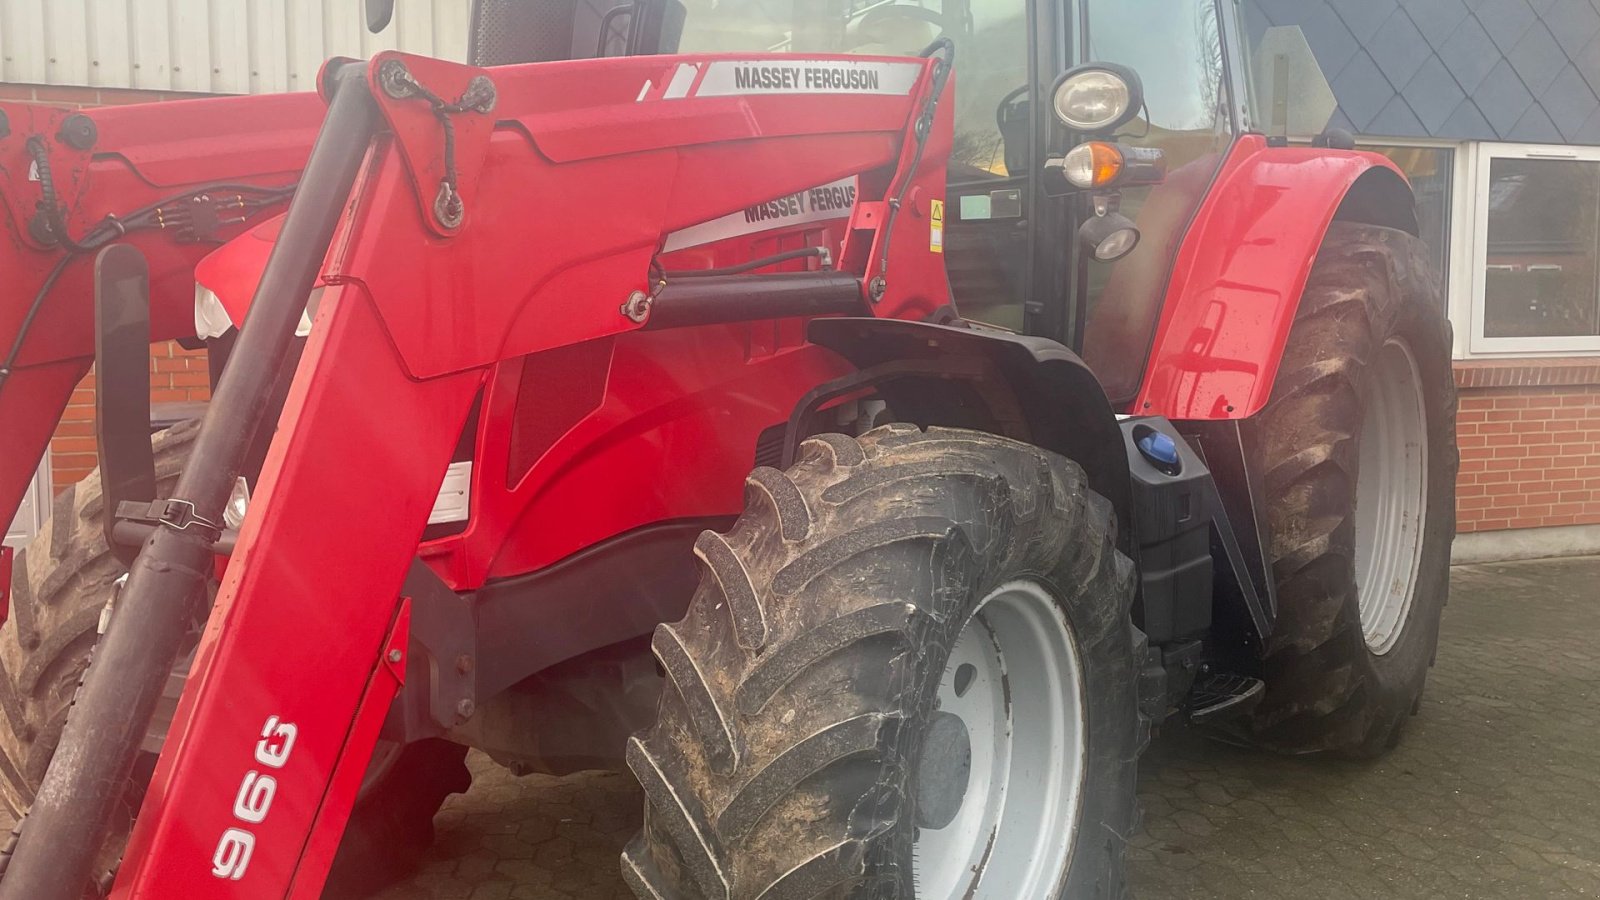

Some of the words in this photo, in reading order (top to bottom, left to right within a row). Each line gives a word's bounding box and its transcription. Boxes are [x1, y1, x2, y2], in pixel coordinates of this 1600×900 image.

[734, 67, 800, 89] MASSEY
[804, 68, 879, 90] FERGUSON
[744, 192, 804, 223] MASSEY
